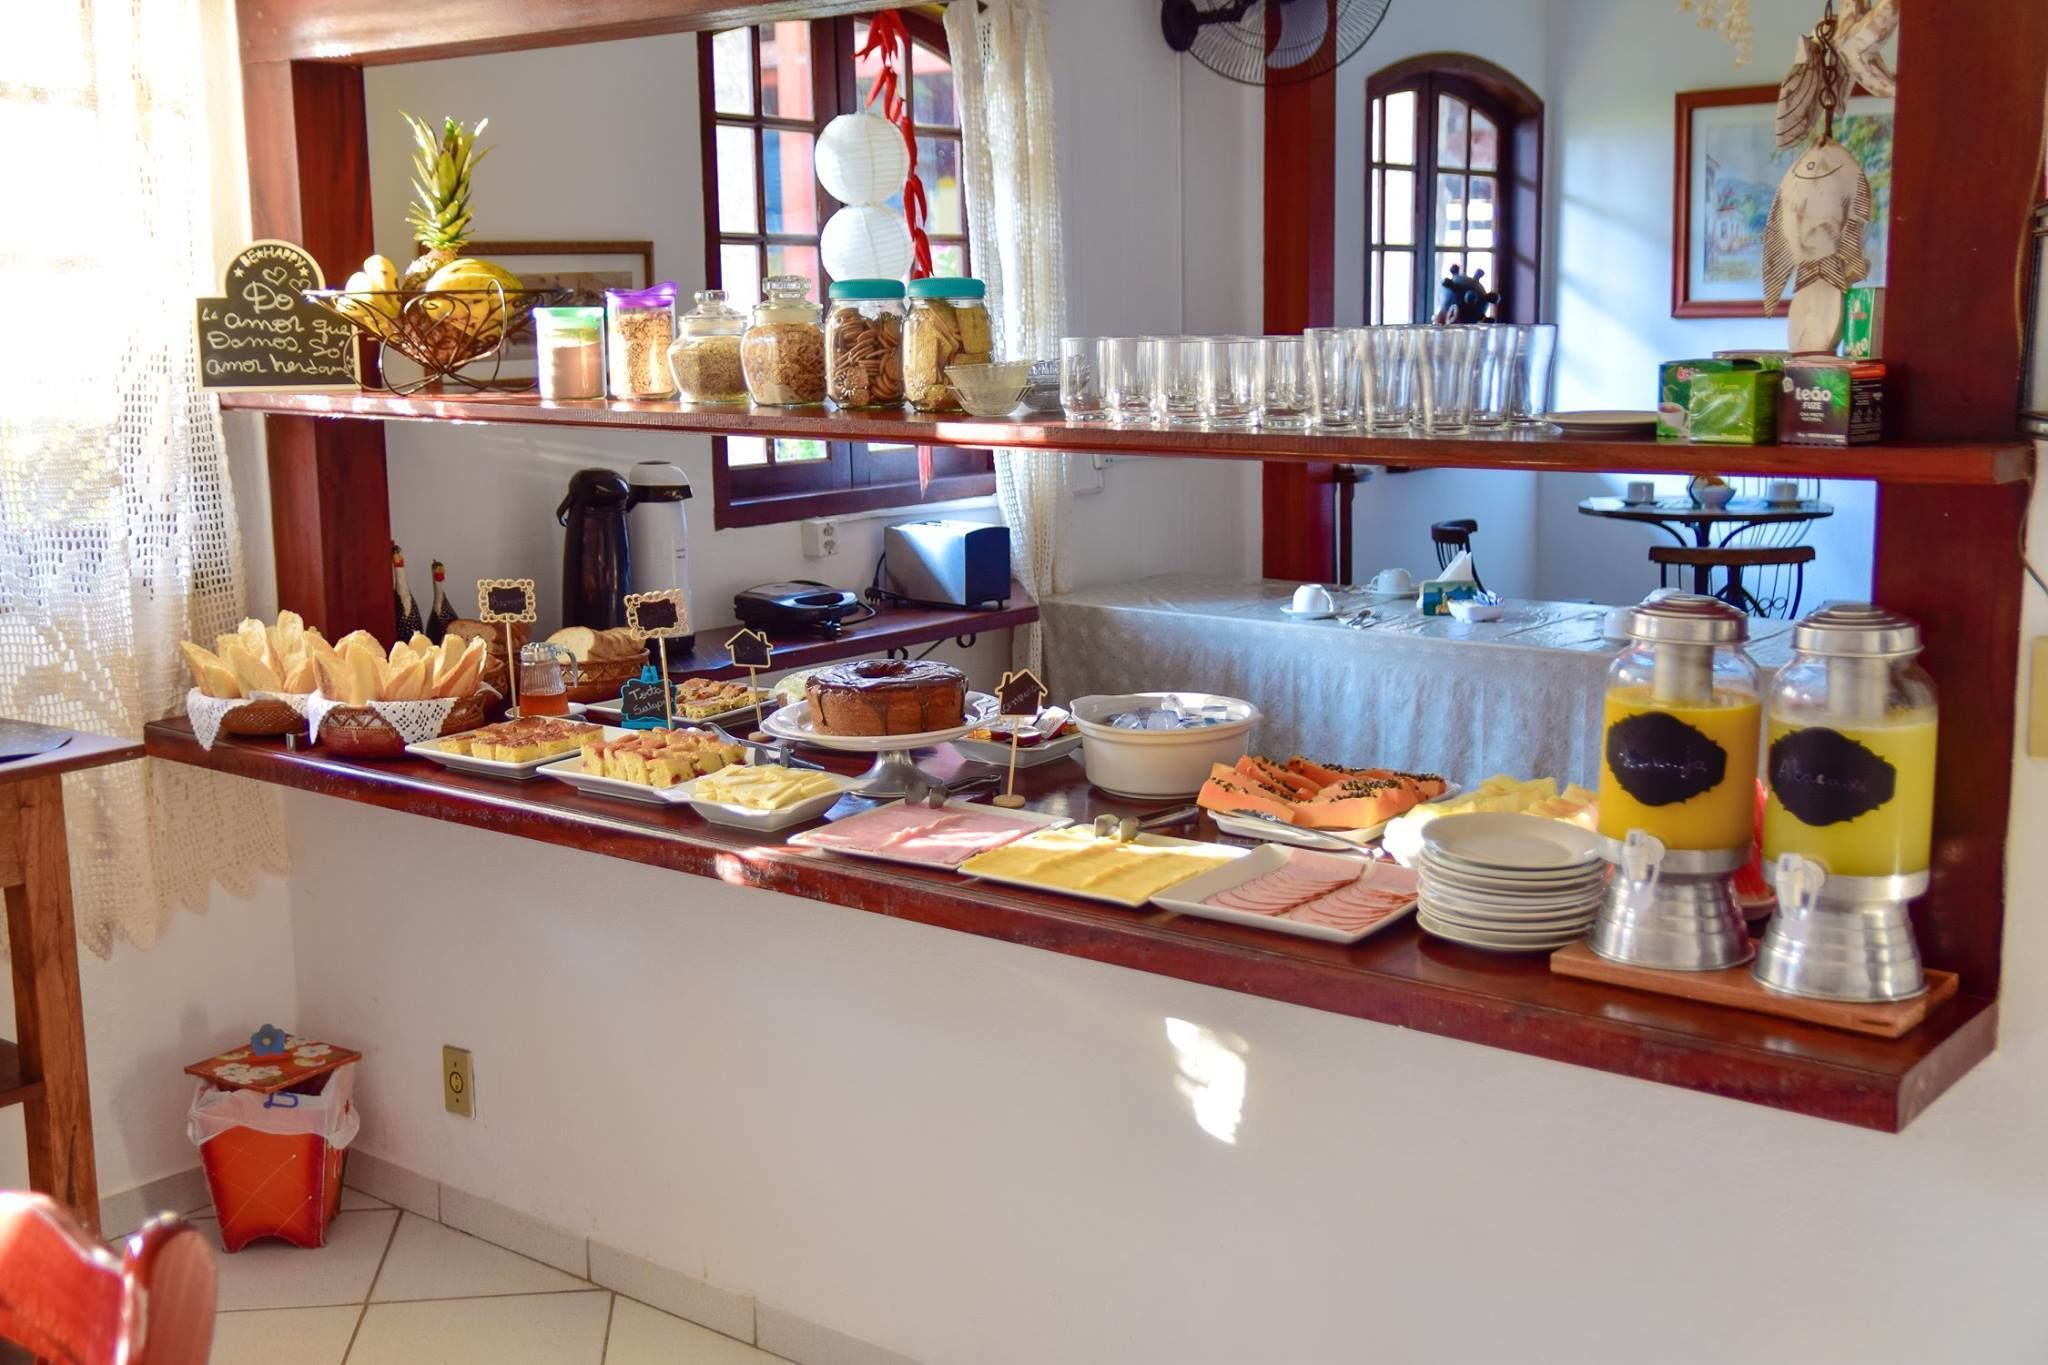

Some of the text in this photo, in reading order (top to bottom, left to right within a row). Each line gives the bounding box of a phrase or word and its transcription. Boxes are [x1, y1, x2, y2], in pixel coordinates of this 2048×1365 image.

[262, 246, 307, 268] HAPPY
[312, 319, 351, 344] que
[206, 358, 268, 375] amor
